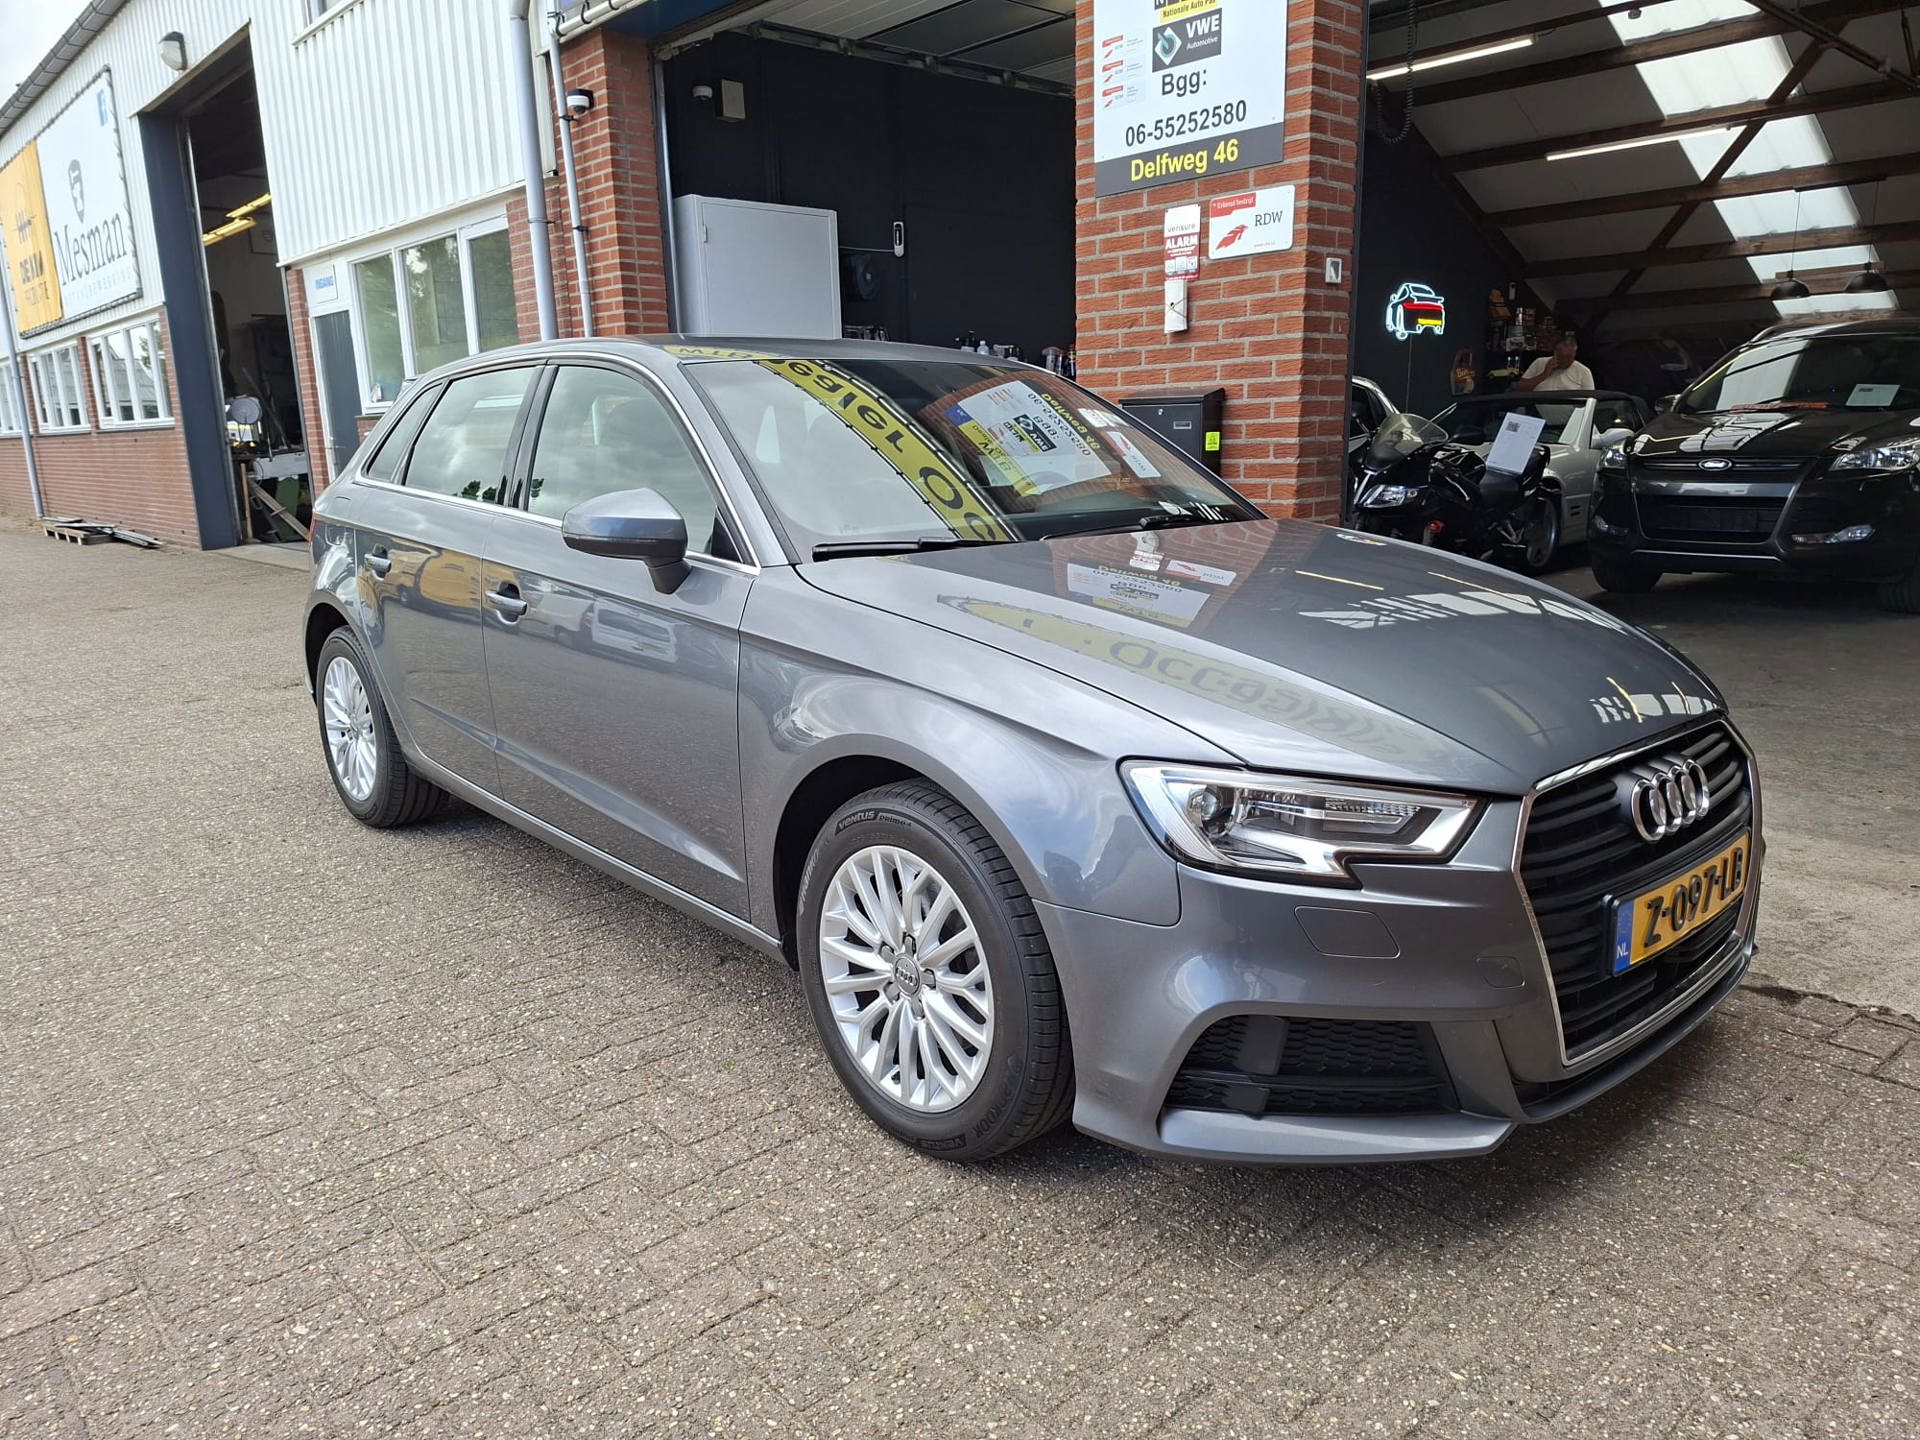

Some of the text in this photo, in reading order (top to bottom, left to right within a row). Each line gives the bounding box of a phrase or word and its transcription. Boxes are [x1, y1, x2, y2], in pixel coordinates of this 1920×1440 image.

[1190, 0, 1204, 10] Auto
[1185, 14, 1220, 38] VWE
[1186, 35, 1219, 50] Automotive
[1161, 68, 1208, 97] Bgg:
[1125, 99, 1247, 148] 06-55252580
[1130, 138, 1239, 182] Delfweg 46
[1254, 210, 1284, 228] RDW
[54, 211, 128, 286] Mesman
[1165, 234, 1198, 250] ALARM
[1644, 846, 1744, 949] Z-097-LB
[1616, 942, 1629, 960] NL
